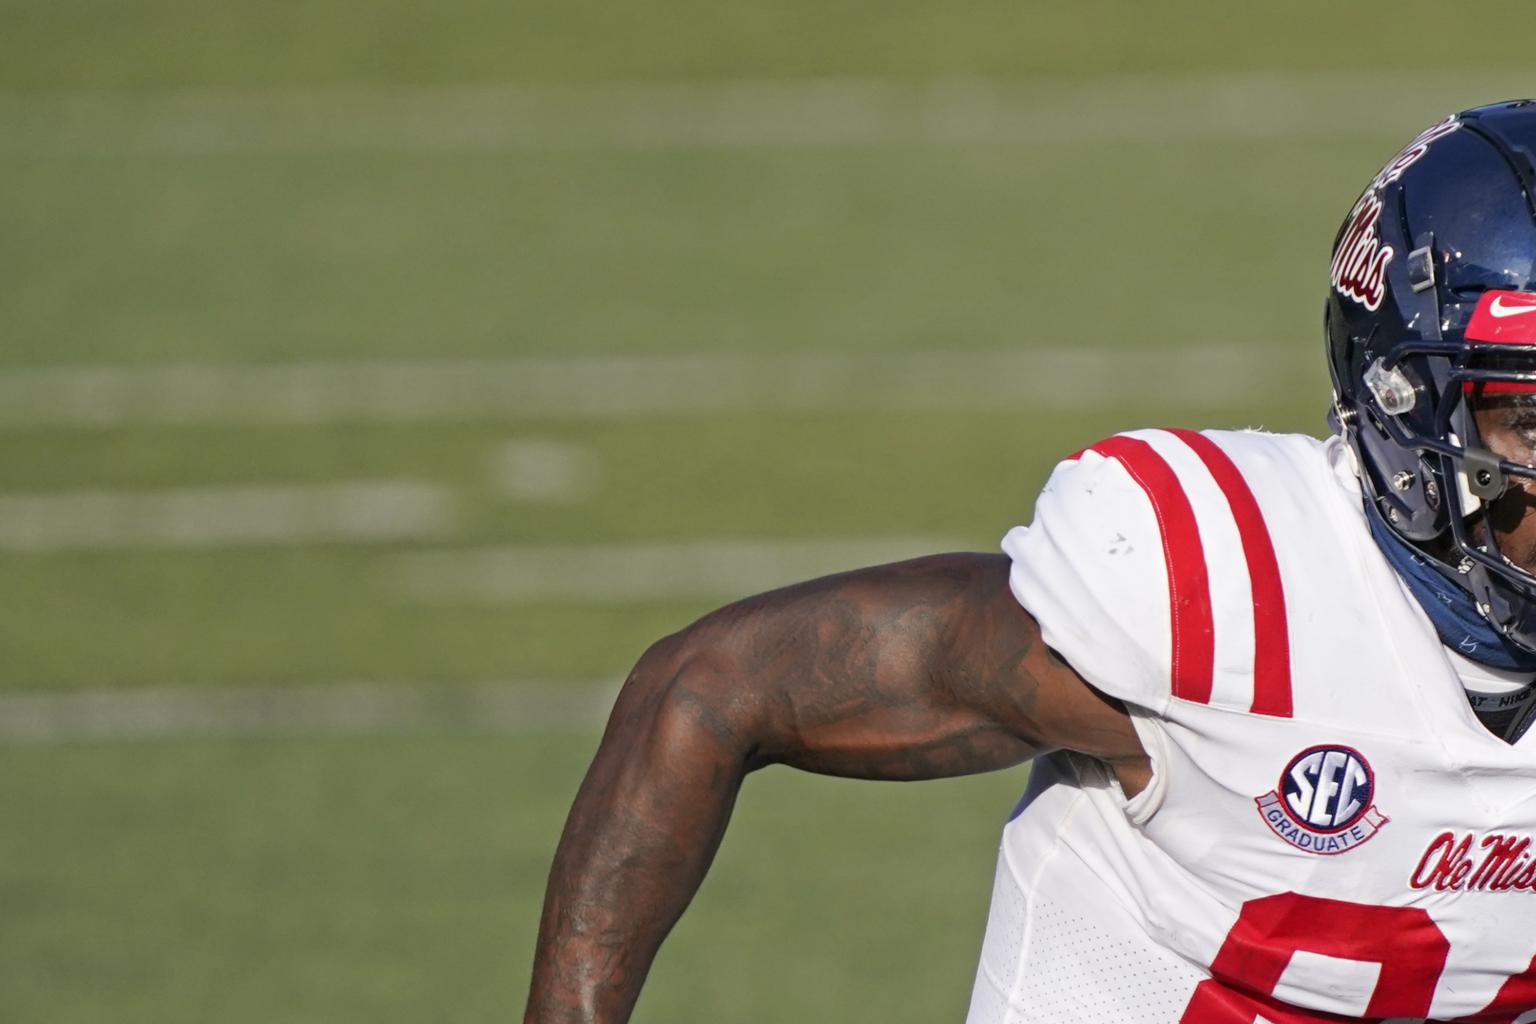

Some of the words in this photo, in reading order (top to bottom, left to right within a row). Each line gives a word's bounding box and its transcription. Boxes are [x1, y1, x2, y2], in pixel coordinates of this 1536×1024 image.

[1330, 188, 1394, 311] Miss
[1286, 750, 1368, 827] SEC
[1266, 809, 1366, 852] GRADUATE
[1409, 831, 1474, 891] Ole
